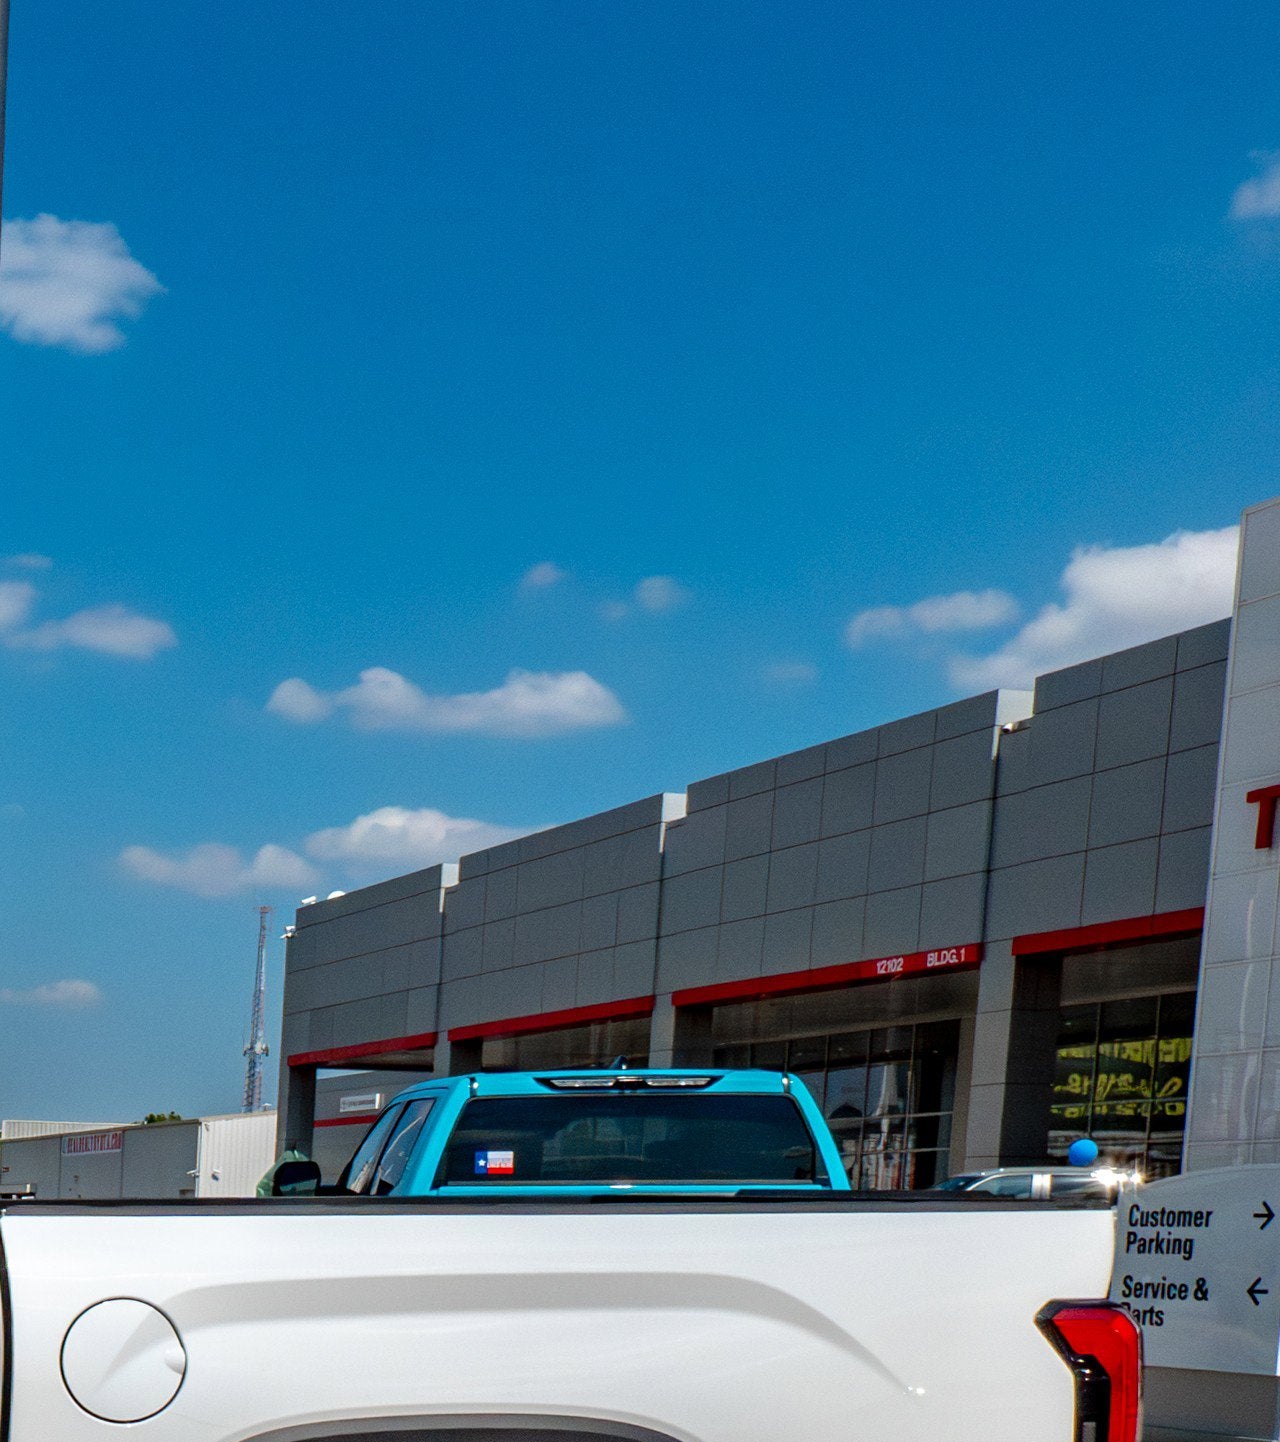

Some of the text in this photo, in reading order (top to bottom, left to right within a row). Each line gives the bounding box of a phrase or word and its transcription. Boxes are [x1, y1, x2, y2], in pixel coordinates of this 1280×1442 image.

[876, 957, 904, 975] 12102
[1128, 1203, 1213, 1228] Customer
[1126, 1230, 1194, 1261] Parking
[1121, 1274, 1209, 1301] Service &
